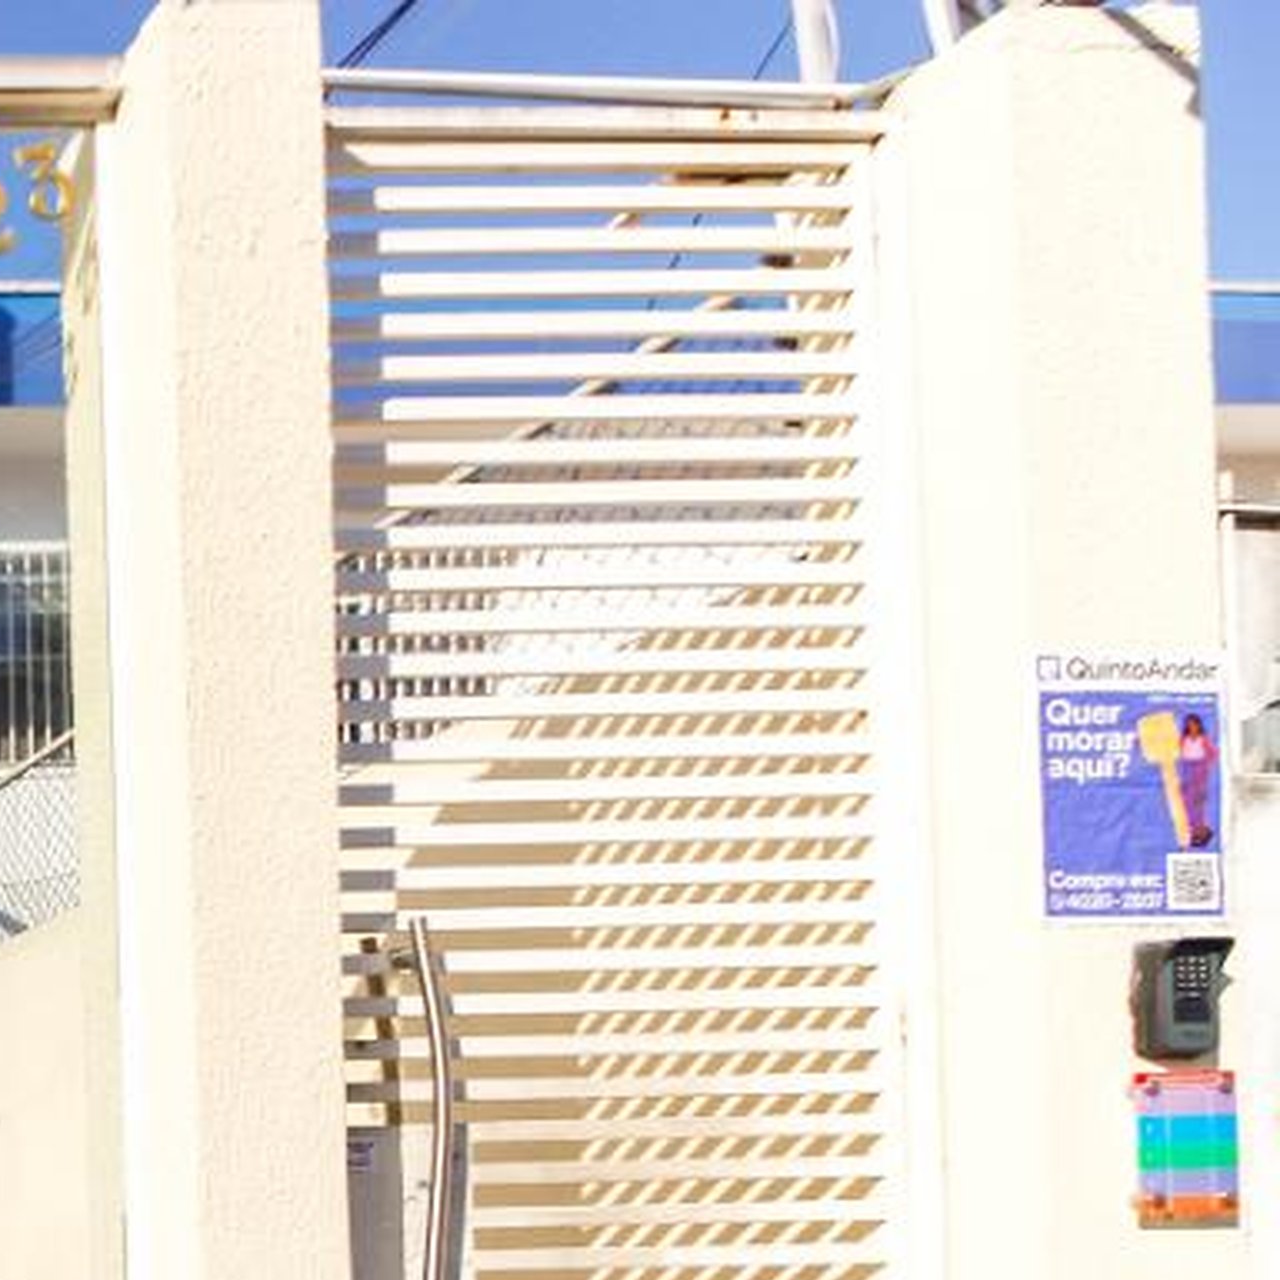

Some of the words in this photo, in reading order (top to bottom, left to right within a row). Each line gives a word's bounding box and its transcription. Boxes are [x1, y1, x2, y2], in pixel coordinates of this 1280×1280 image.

[1065, 656, 1219, 682] QuintoAndar
[1045, 698, 1124, 727] Quer
[1046, 730, 1138, 752] morar
[1048, 753, 1131, 785] aqui?
